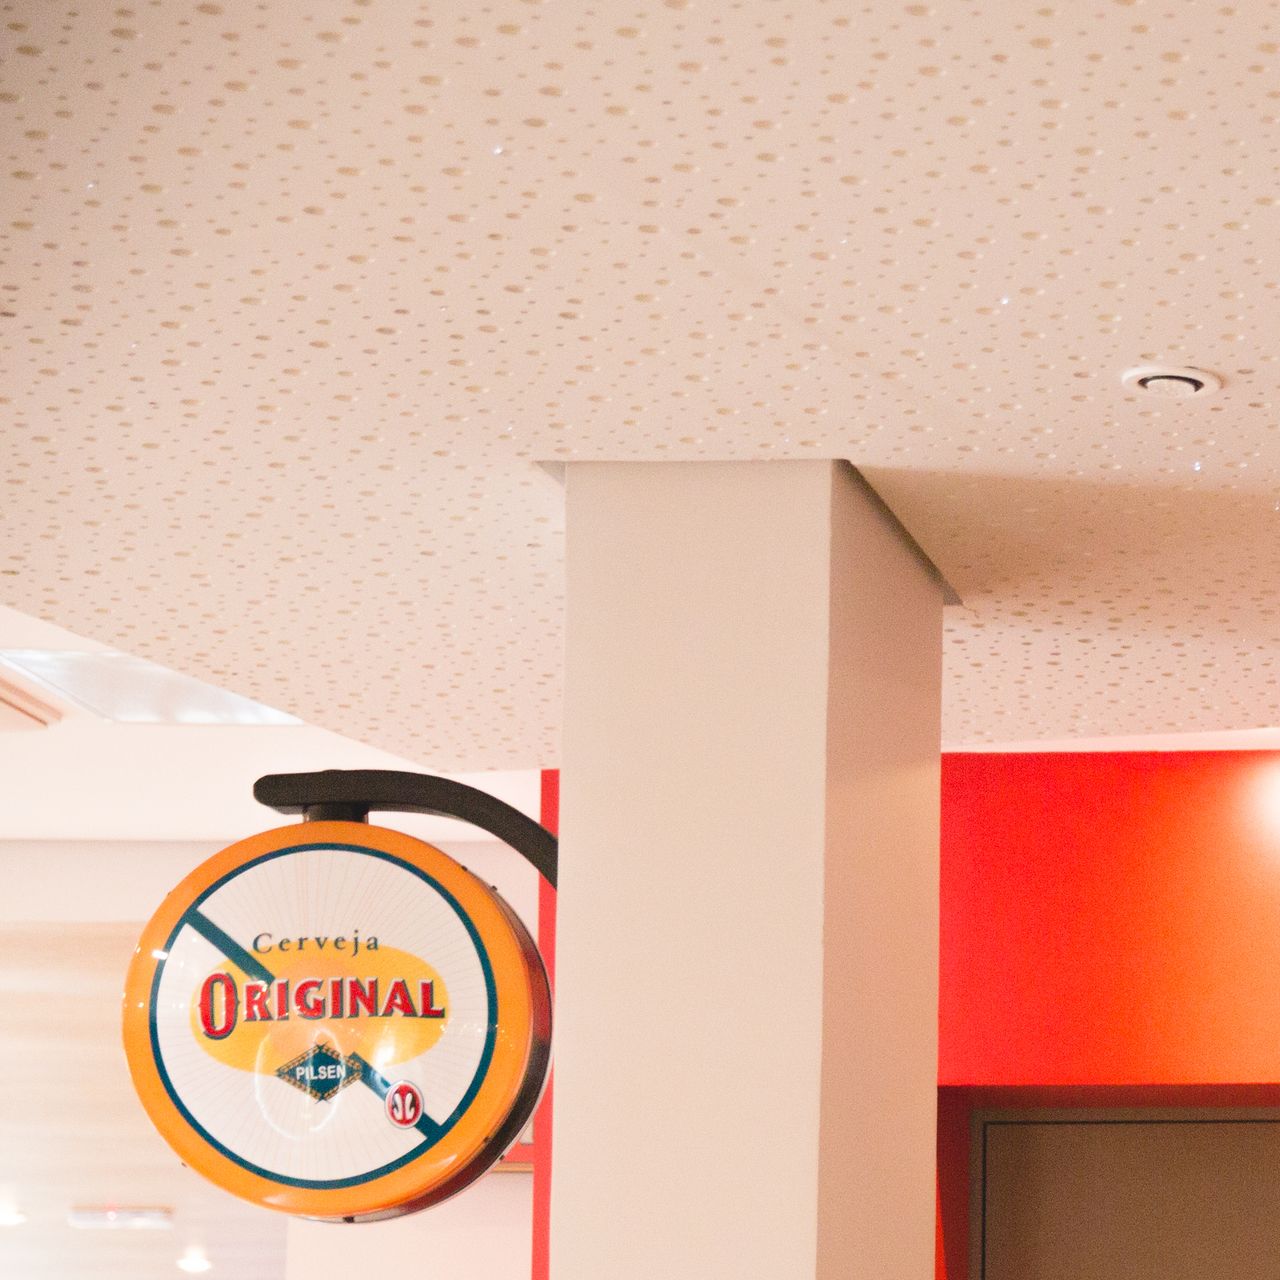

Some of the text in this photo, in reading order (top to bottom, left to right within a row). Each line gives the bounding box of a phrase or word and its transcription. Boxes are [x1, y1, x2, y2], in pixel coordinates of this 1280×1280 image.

[252, 930, 380, 957] Cerveja
[198, 973, 445, 1040] ORIGINAL
[296, 1065, 346, 1080] PILSEN
